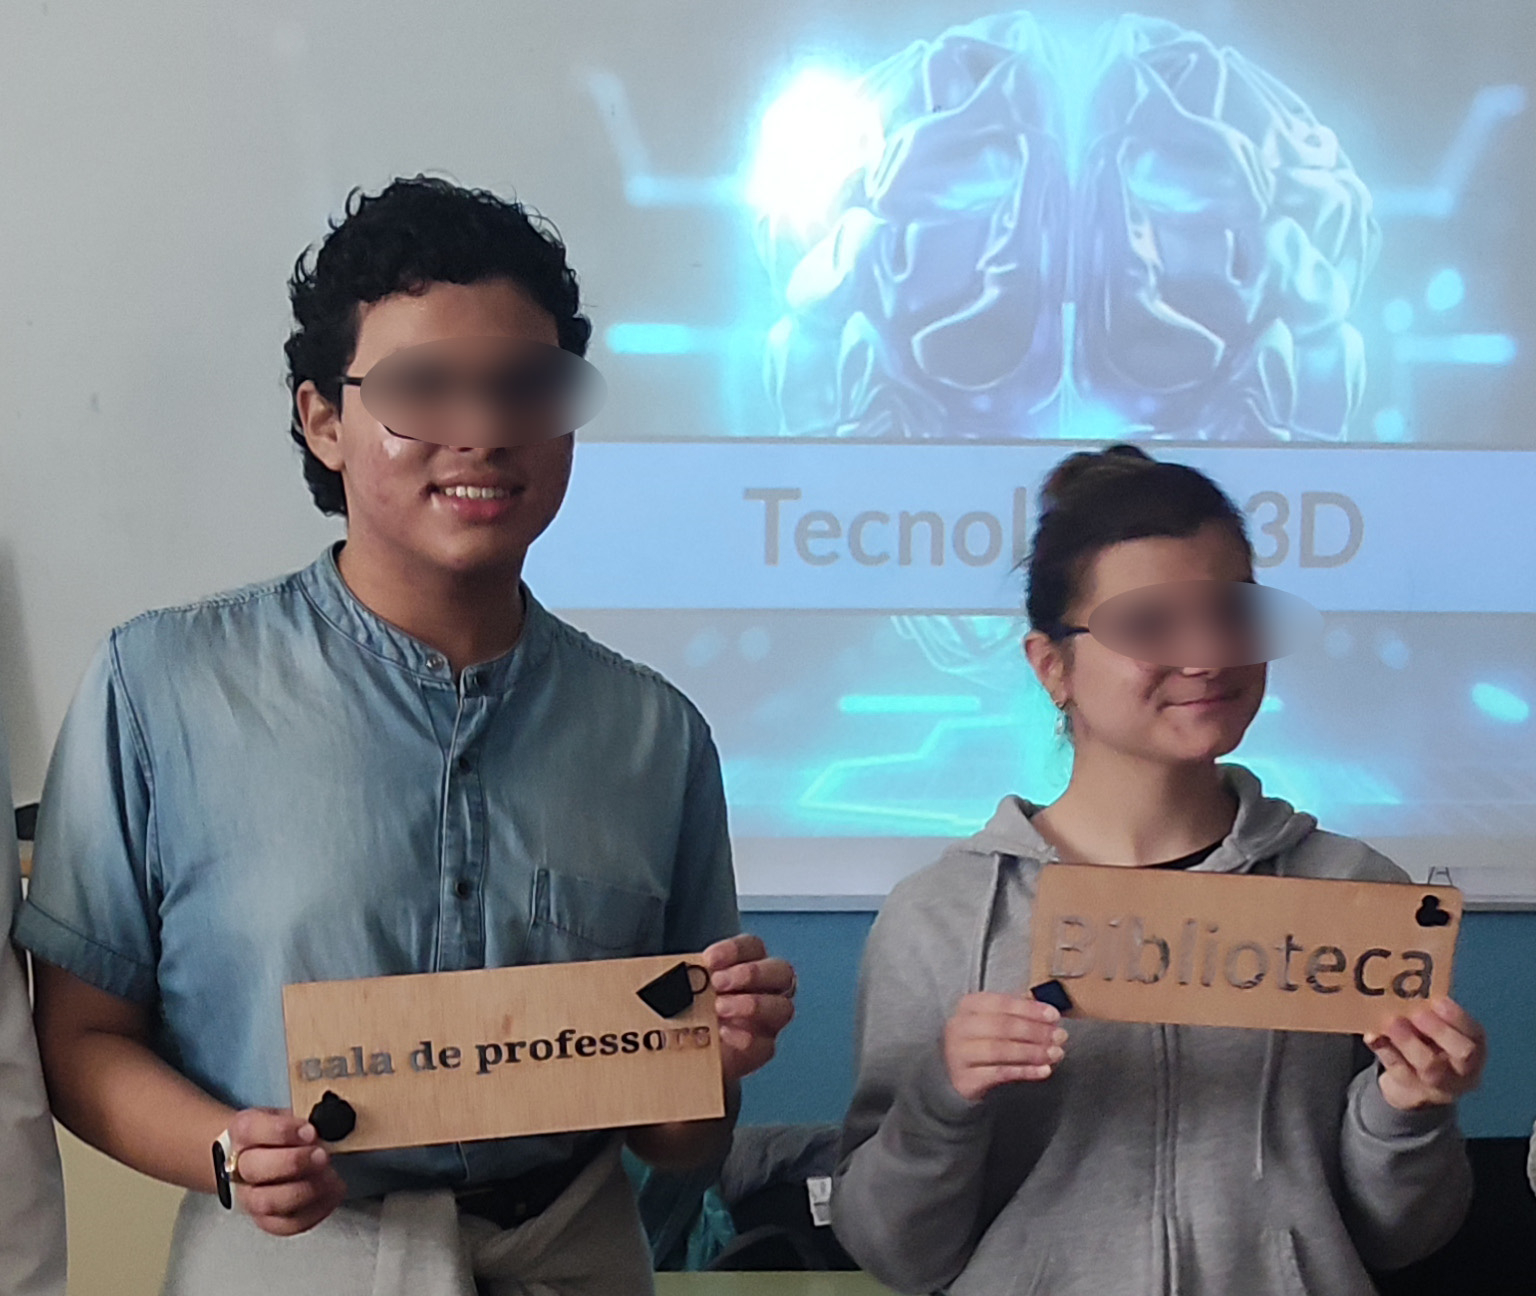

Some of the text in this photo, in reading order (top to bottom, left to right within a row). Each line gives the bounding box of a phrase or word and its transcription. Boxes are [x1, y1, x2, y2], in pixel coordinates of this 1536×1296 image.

[742, 486, 1364, 569] Tecnol 3D
[1048, 915, 1434, 1000] Biblioteca
[299, 1024, 711, 1082] sala de professors
